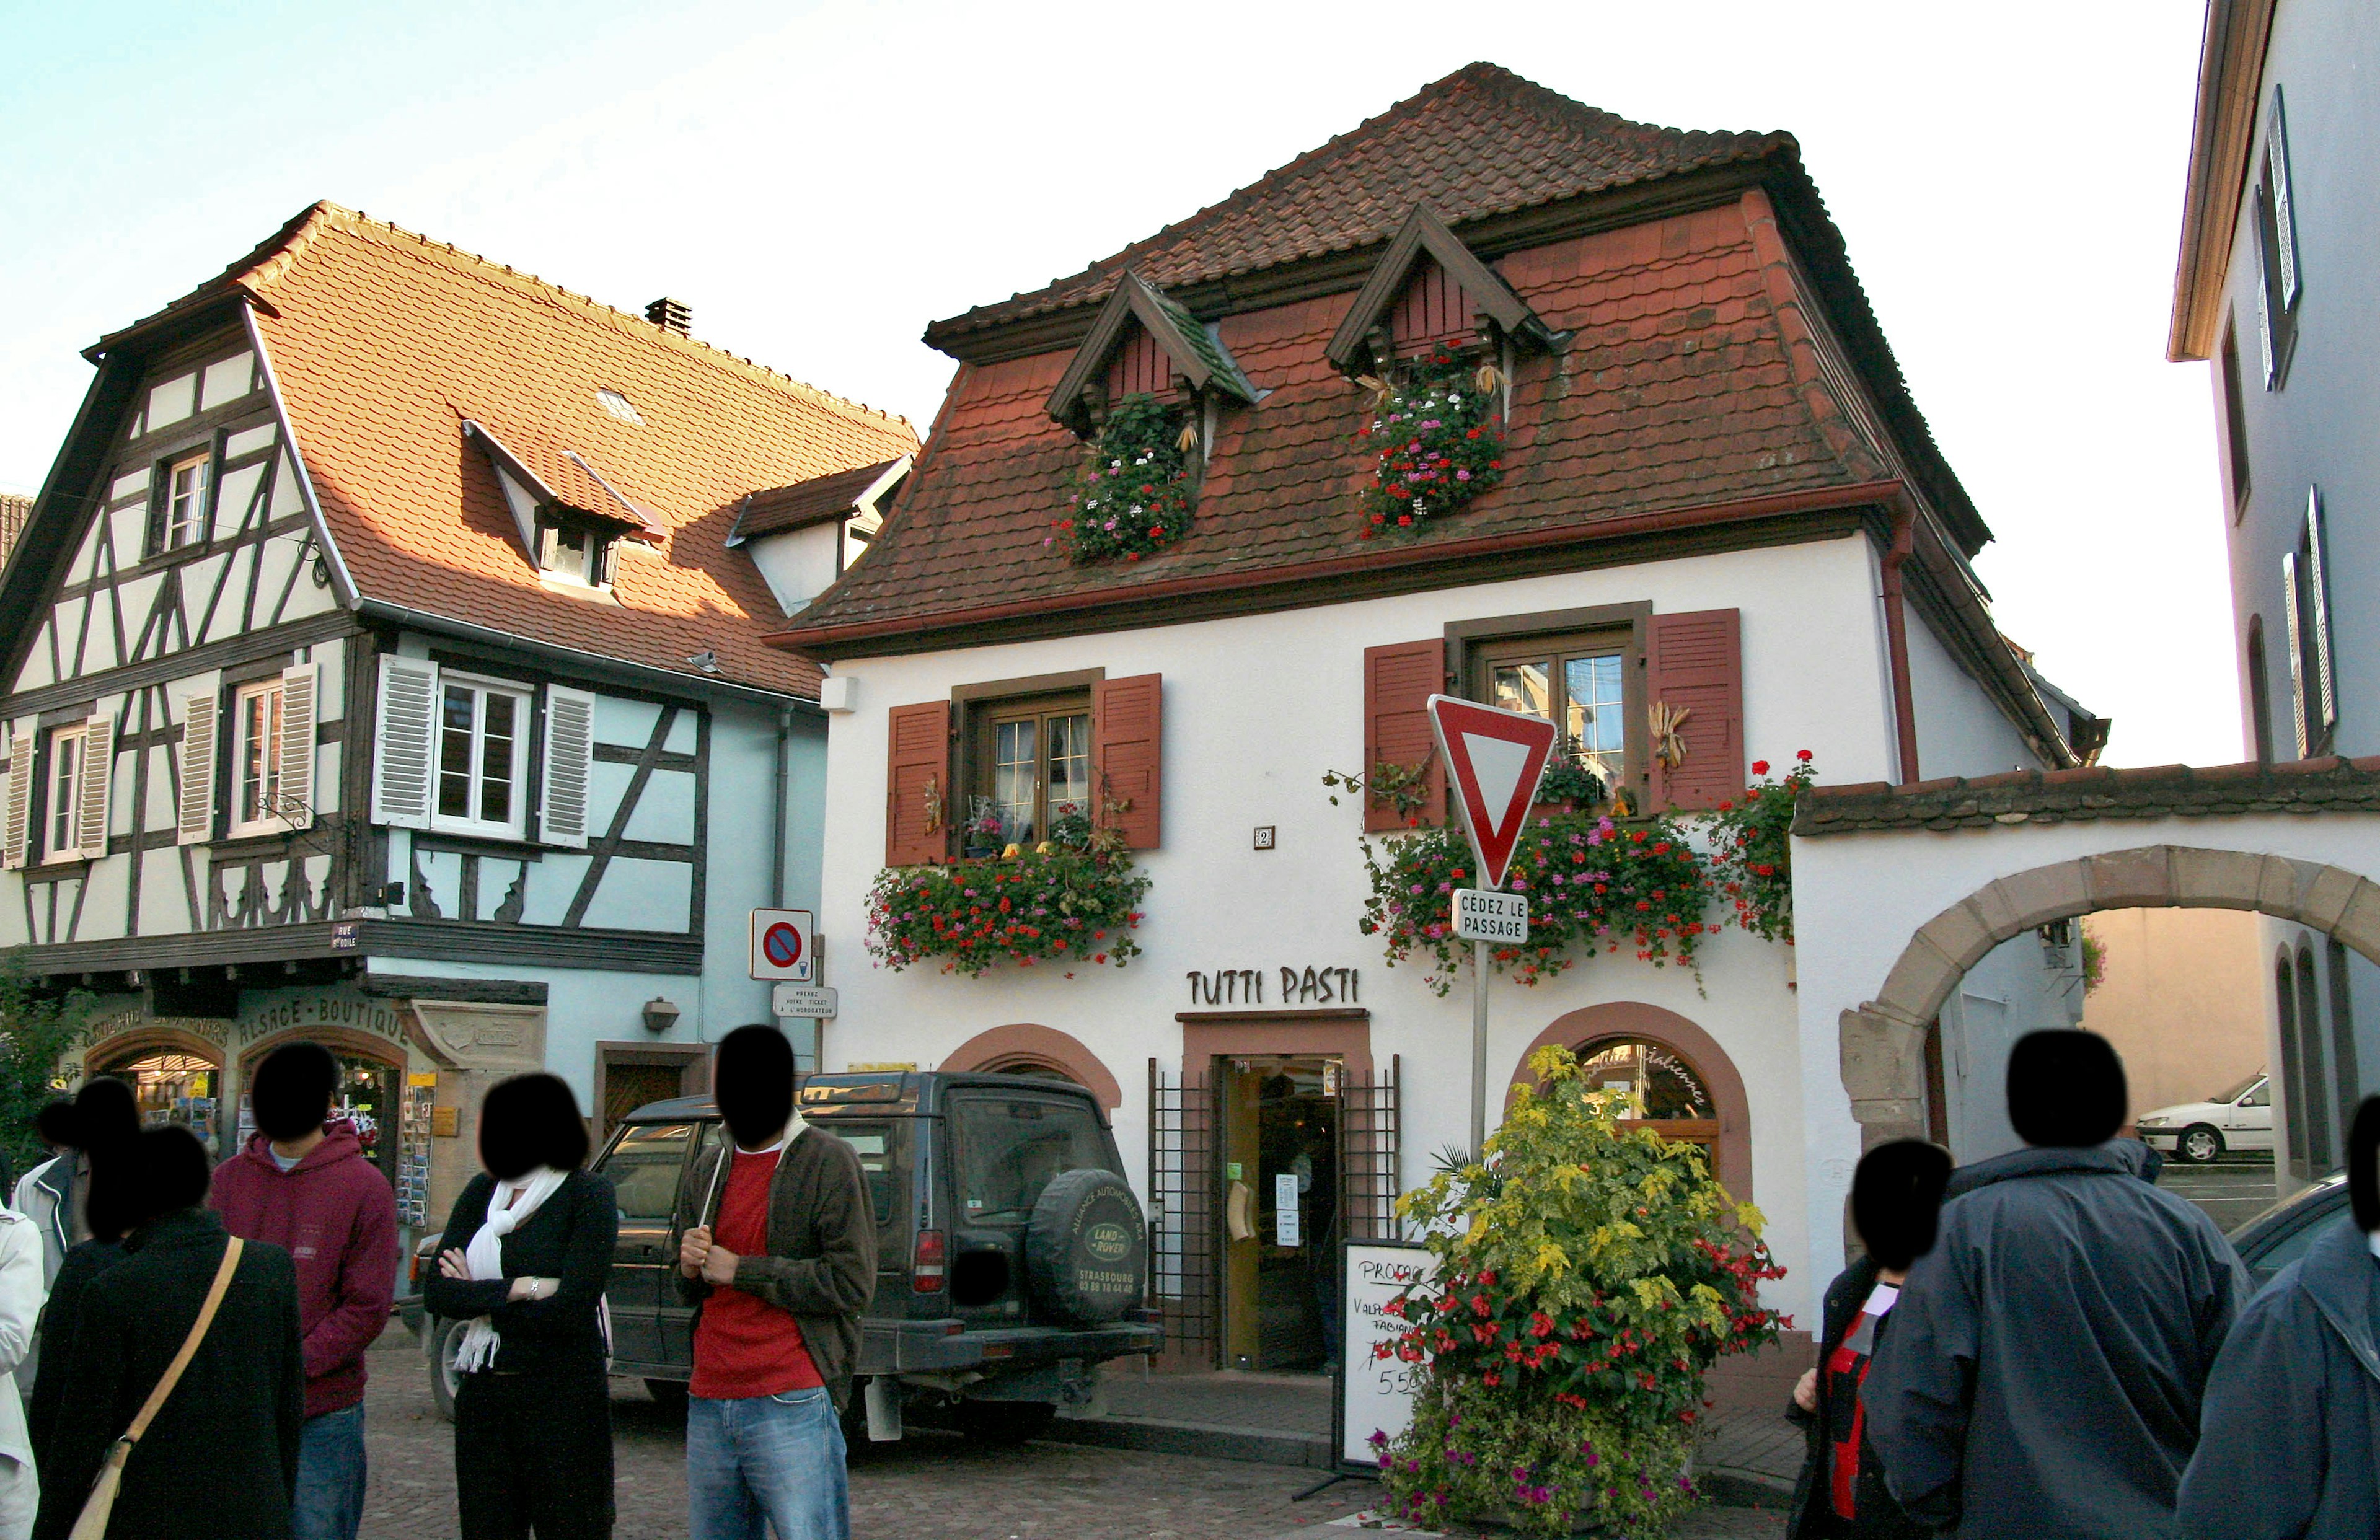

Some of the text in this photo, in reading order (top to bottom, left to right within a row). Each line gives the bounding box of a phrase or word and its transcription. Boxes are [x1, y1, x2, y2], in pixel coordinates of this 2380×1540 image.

[1261, 832, 1267, 843] 2
[1461, 894, 1524, 917] CÉDEZ LE
[338, 926, 351, 935] RUE
[1465, 917, 1522, 937] PASSAGE
[1186, 964, 1359, 1005] TUTTI PASTI
[239, 998, 408, 1046] ALSACE BOUTIQUE
[1072, 1192, 1096, 1235] ALLIANCE
[1097, 1186, 1140, 1220] AUTOMOBILES
[1095, 1230, 1117, 1240] LAND
[1096, 1241, 1126, 1254] ROVER
[1080, 1270, 1134, 1283] STRASBOURG
[1079, 1282, 1088, 1291] 03
